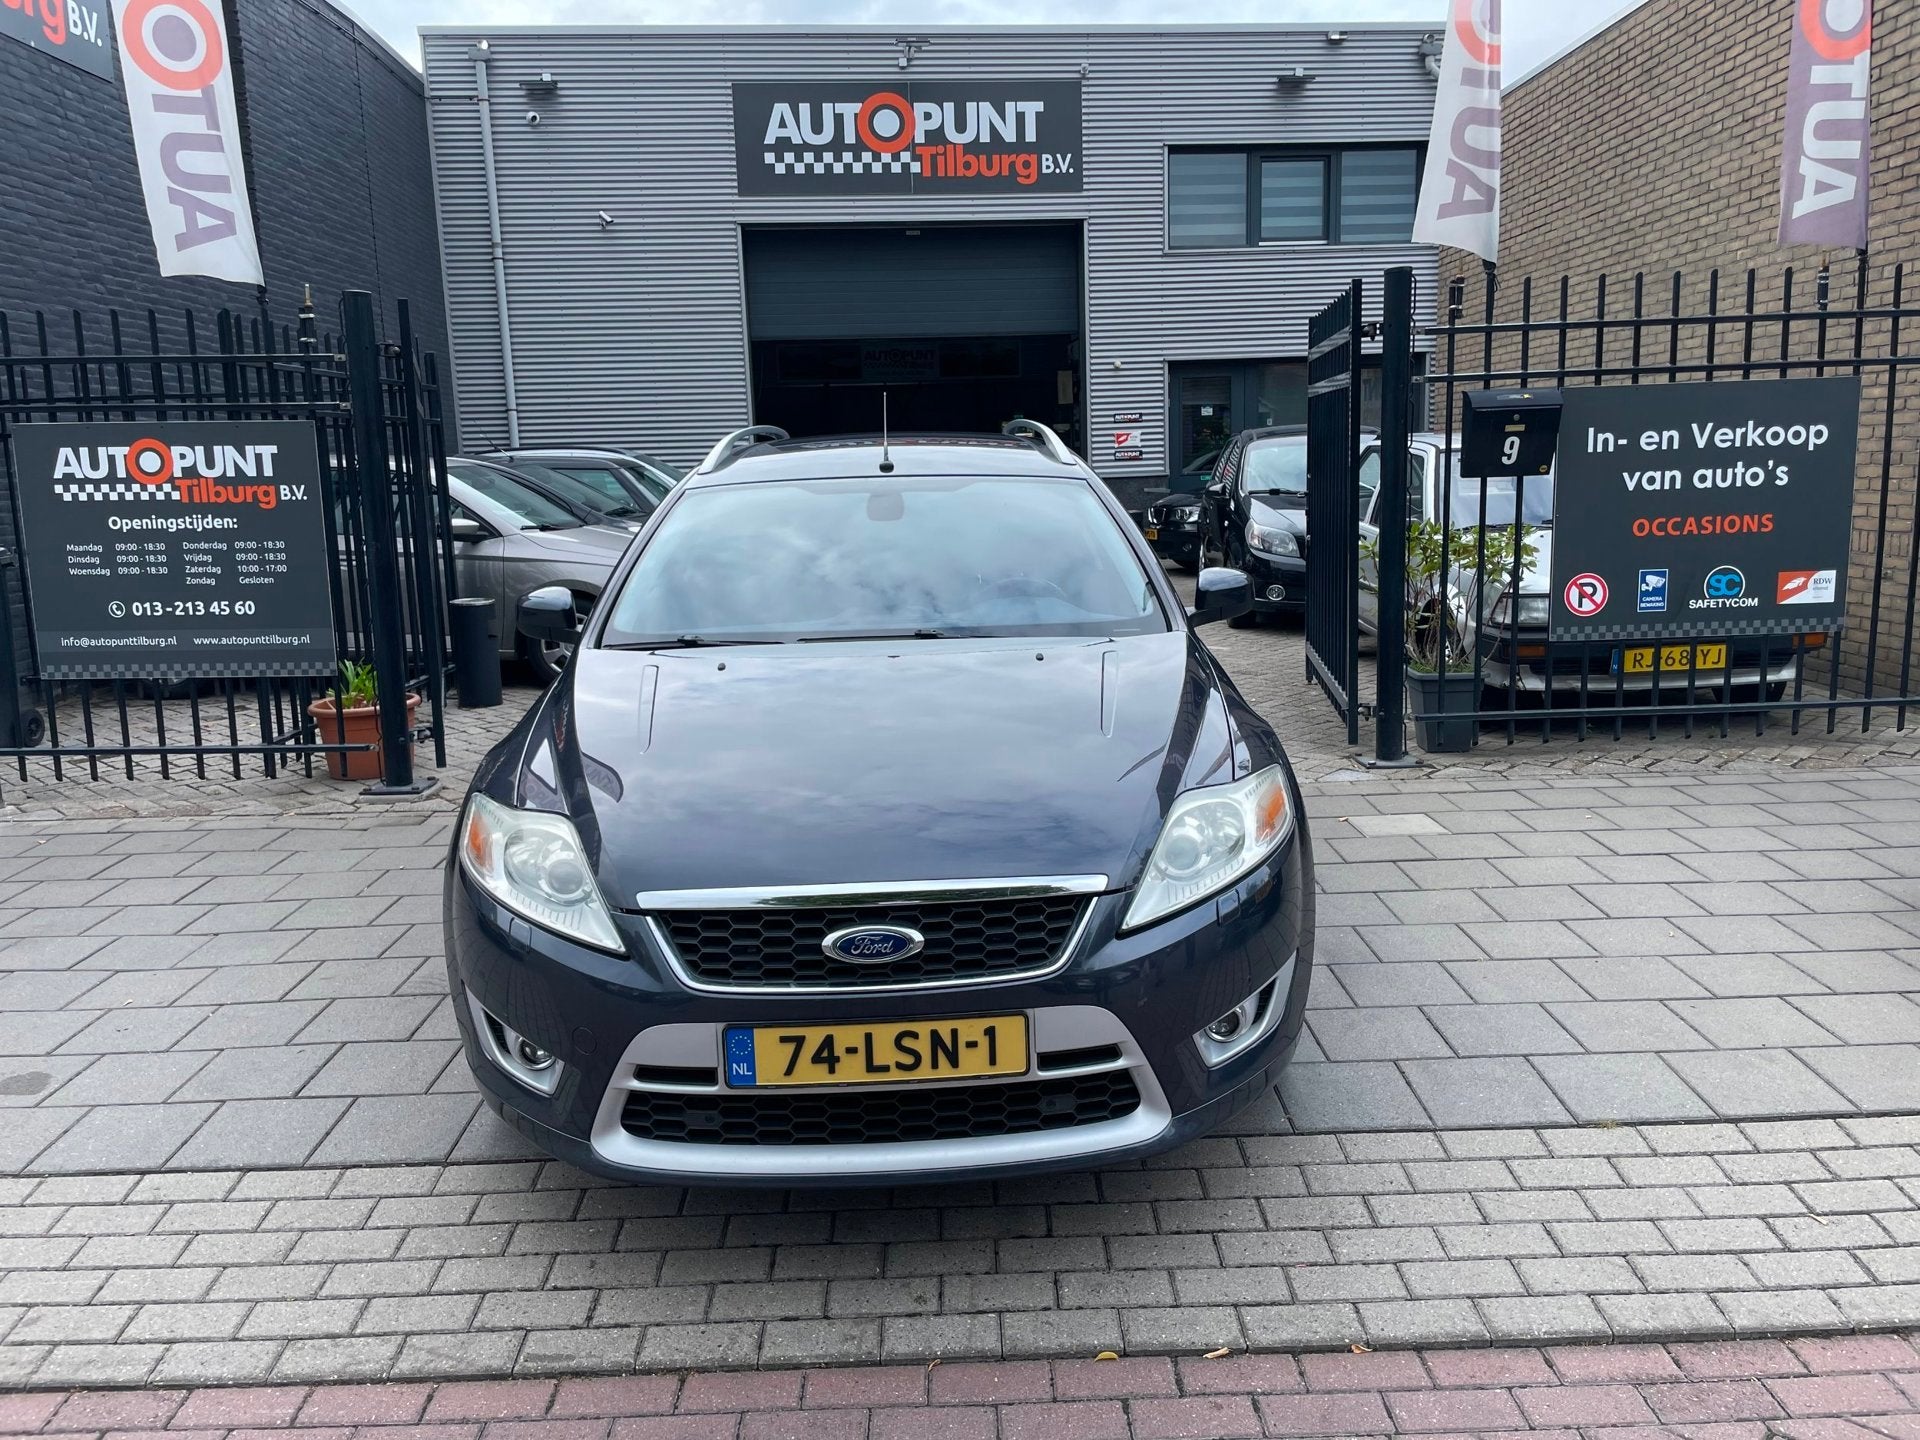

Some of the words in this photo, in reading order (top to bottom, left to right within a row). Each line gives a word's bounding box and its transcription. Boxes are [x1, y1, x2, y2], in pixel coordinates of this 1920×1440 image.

[764, 92, 1044, 154] AUTOPUNT
[915, 144, 1038, 185] Tilburg
[1041, 153, 1074, 174] B.V.
[1587, 427, 1628, 453] In-
[1639, 429, 1679, 451] en
[1691, 420, 1829, 451] Verkoop
[1501, 435, 1520, 465] 9
[53, 437, 278, 485] AUTOPUNT
[1622, 469, 1681, 491] van
[174, 477, 278, 509] Tilburg
[279, 484, 308, 501] B.V.
[108, 514, 238, 532] Openingstijden:
[1632, 513, 1774, 537] OCCASIONS
[66, 543, 103, 553] Maandag
[115, 543, 138, 551] 09:00
[143, 542, 166, 551] 18:30
[182, 541, 228, 551] Donderdag
[234, 541, 257, 549] 09:00
[263, 540, 285, 549] 18:30
[67, 555, 100, 565] Dinsdag
[116, 555, 139, 563] 09:00
[145, 554, 167, 563] 18:30
[183, 553, 213, 563] Vrijdag
[235, 553, 258, 561] 09:00
[264, 552, 286, 561] 18:30
[68, 567, 111, 577] Woensdag
[117, 566, 140, 575] 09:00
[146, 566, 168, 575] 18:30
[185, 565, 222, 575] Zaterdag
[237, 564, 260, 573] 10:00
[265, 564, 287, 573] 17:00
[186, 576, 216, 586] Zondag
[239, 575, 275, 585] Gesloten
[1813, 577, 1833, 585] RDW
[209, 600, 231, 615] 45
[234, 600, 256, 615] 60
[1688, 597, 1759, 609] SAFETYCOM
[60, 636, 178, 647] info@autopunttilburg.nl
[193, 634, 311, 646] www.autopunttilburg.nl
[1632, 648, 1722, 669] RJ-68YJ
[850, 935, 894, 956] Ford
[779, 1025, 997, 1076] 74-LSN-1
[732, 1063, 753, 1076] NL
